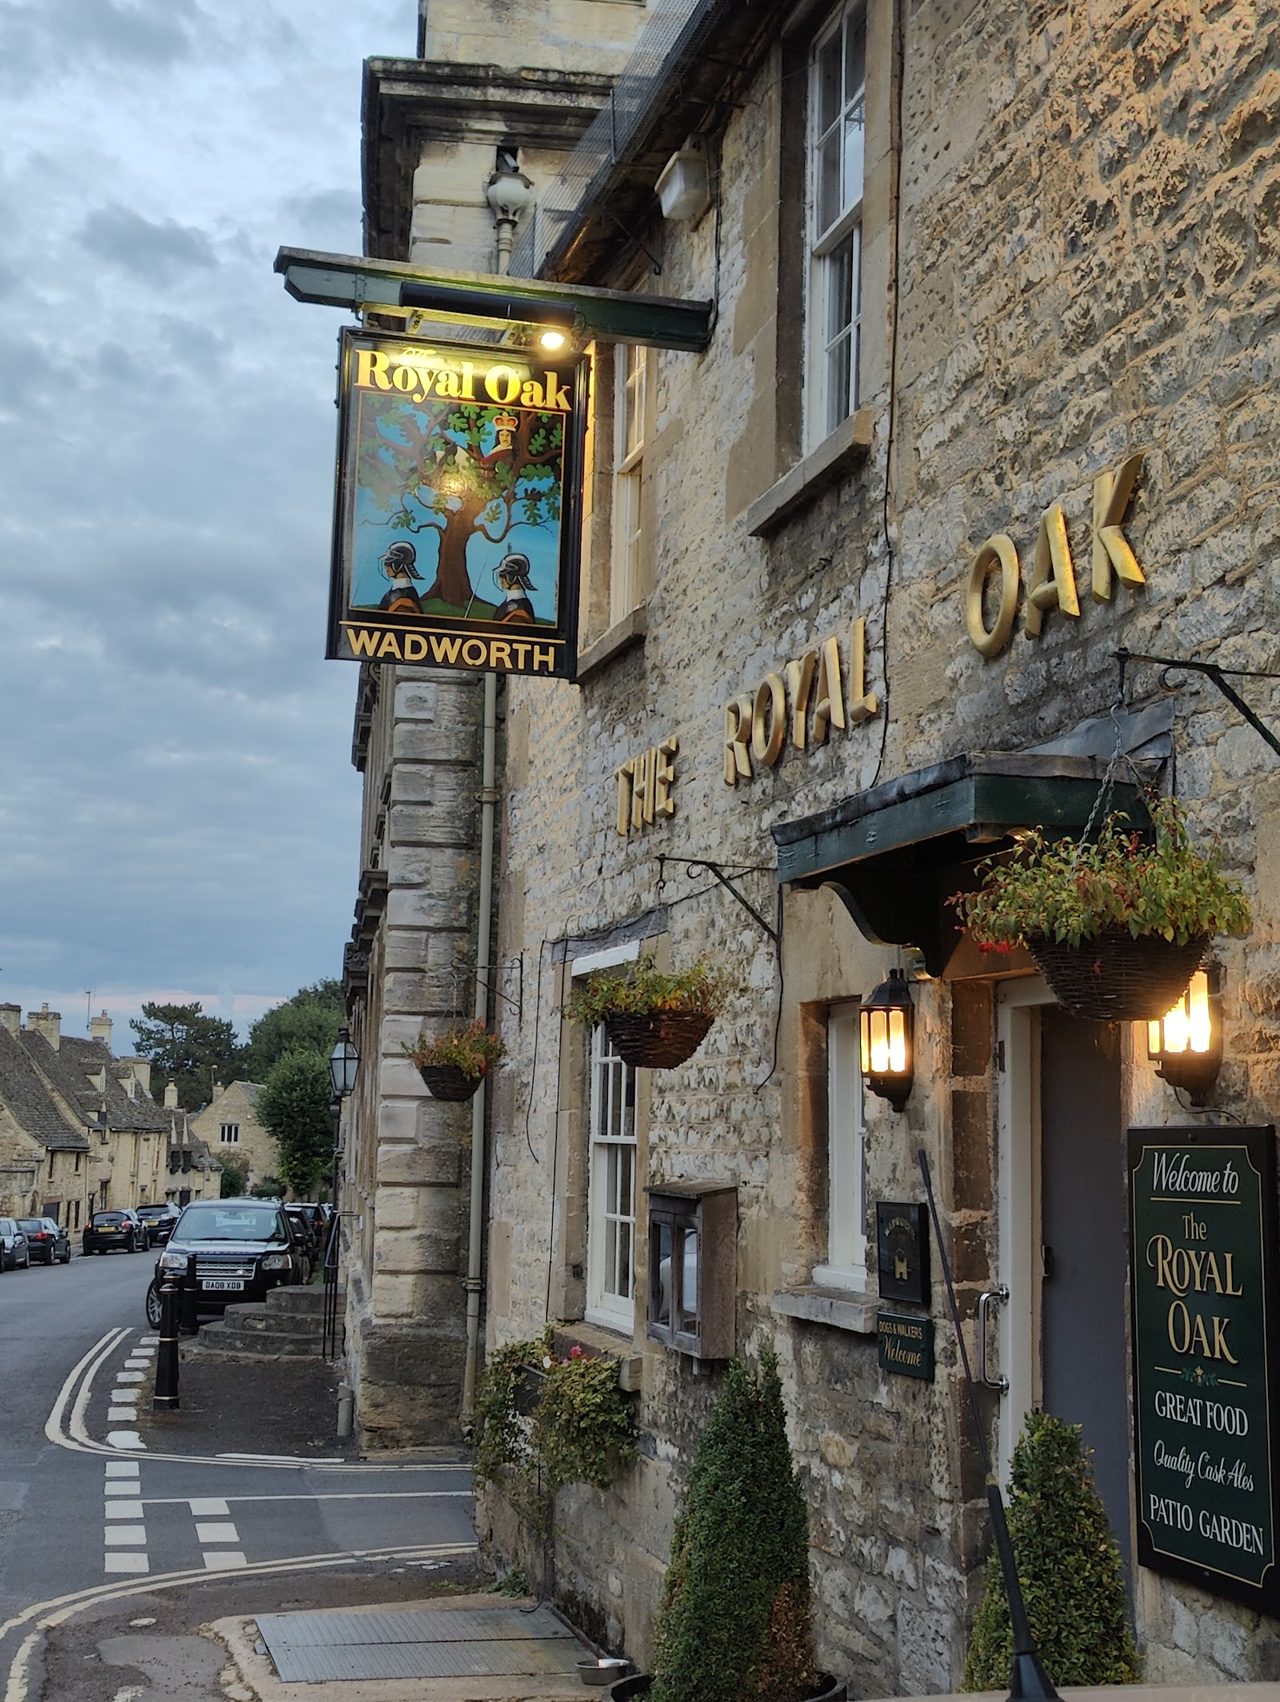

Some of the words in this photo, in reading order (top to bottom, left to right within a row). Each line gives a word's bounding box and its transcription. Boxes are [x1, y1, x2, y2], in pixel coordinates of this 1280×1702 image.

[354, 349, 475, 403] Royal
[484, 364, 573, 411] Oak
[346, 627, 555, 672] WADWORTH
[615, 735, 677, 837] THE
[724, 616, 878, 786] ROYAL
[967, 453, 1146, 658] OAK
[1152, 1151, 1220, 1193] Welcome
[1222, 1160, 1239, 1194] to
[1182, 1211, 1208, 1241] The
[1146, 1234, 1244, 1297] ROYAL
[879, 1321, 892, 1334] DOGS
[897, 1323, 923, 1340] WALKERS
[883, 1335, 921, 1367] Welcome
[1167, 1299, 1239, 1364] OAK
[1154, 1390, 1204, 1427] GREAT
[1206, 1401, 1249, 1436] FOOD
[1153, 1439, 1196, 1489] Quality
[1197, 1450, 1226, 1486] Cask
[1226, 1458, 1255, 1492] Ales
[1149, 1493, 1194, 1533] PATIO
[1198, 1509, 1264, 1556] GARDEN
